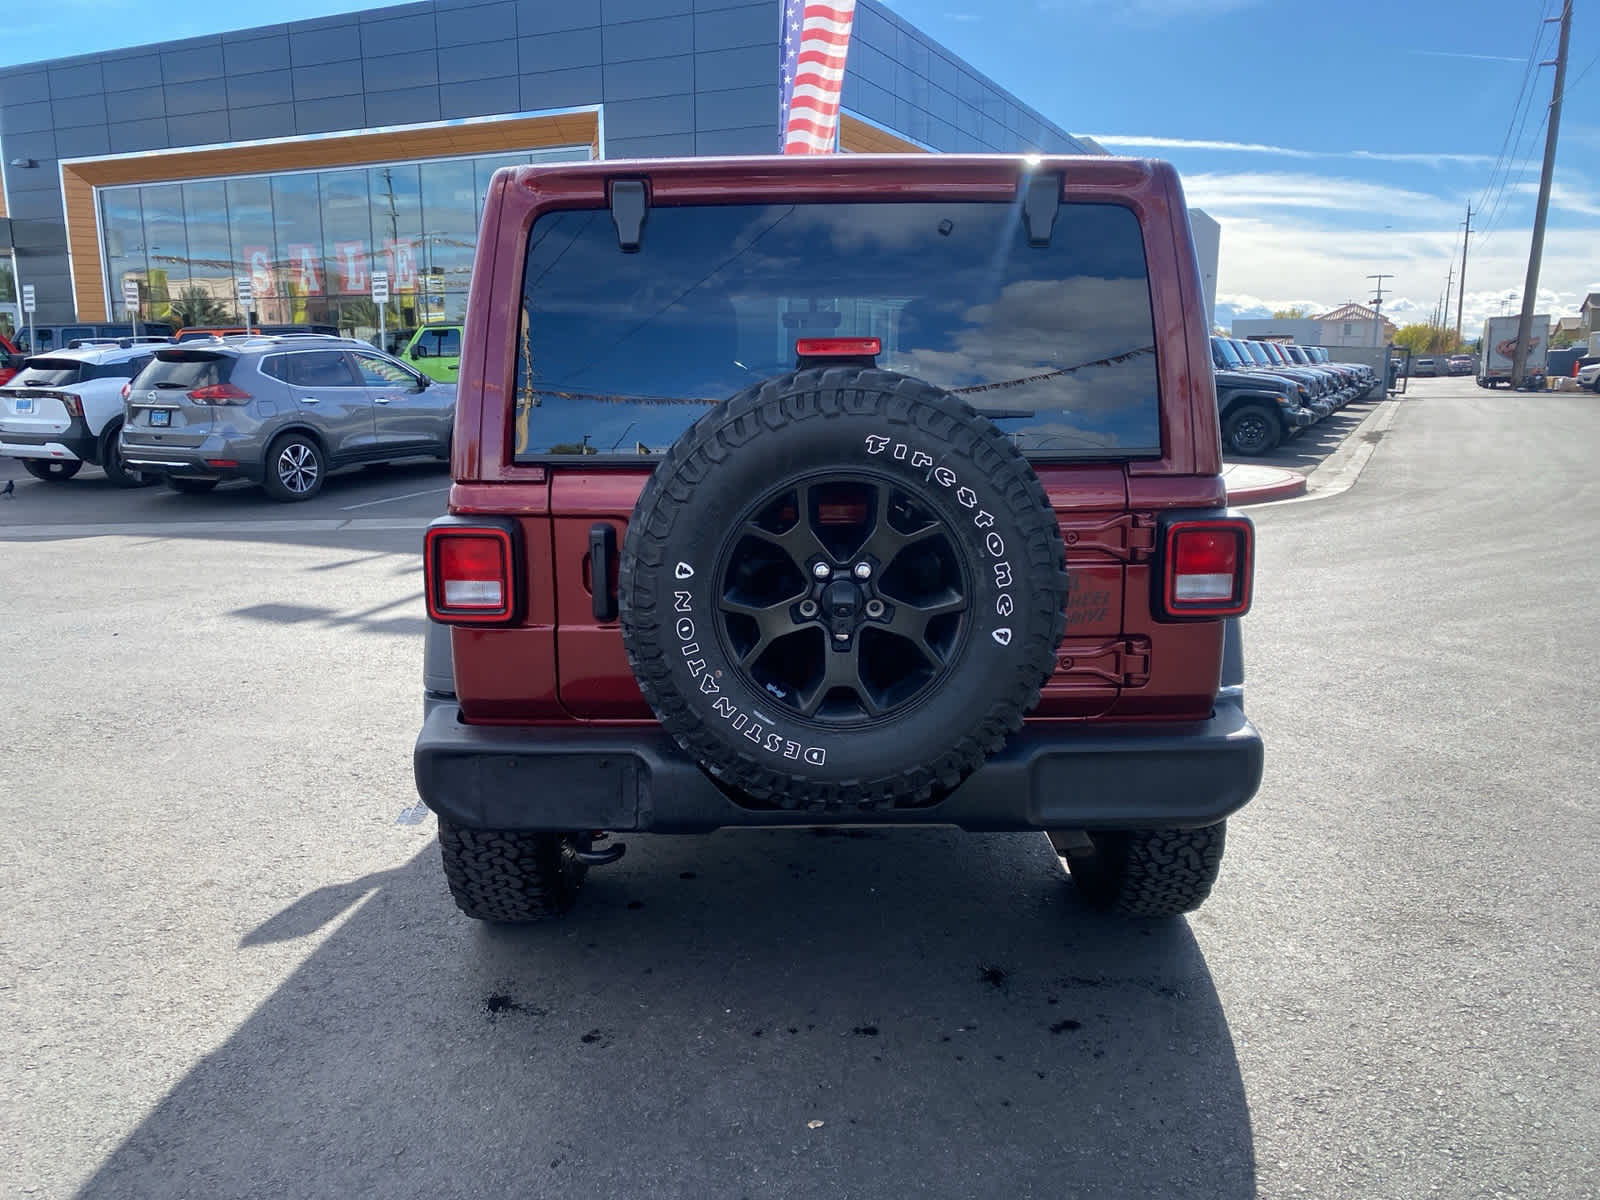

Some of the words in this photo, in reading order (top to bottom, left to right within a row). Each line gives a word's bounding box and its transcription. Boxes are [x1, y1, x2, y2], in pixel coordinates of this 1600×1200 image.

[248, 243, 417, 296] SALE
[865, 434, 1015, 618] Firestone
[673, 591, 827, 766] DESTINATION
